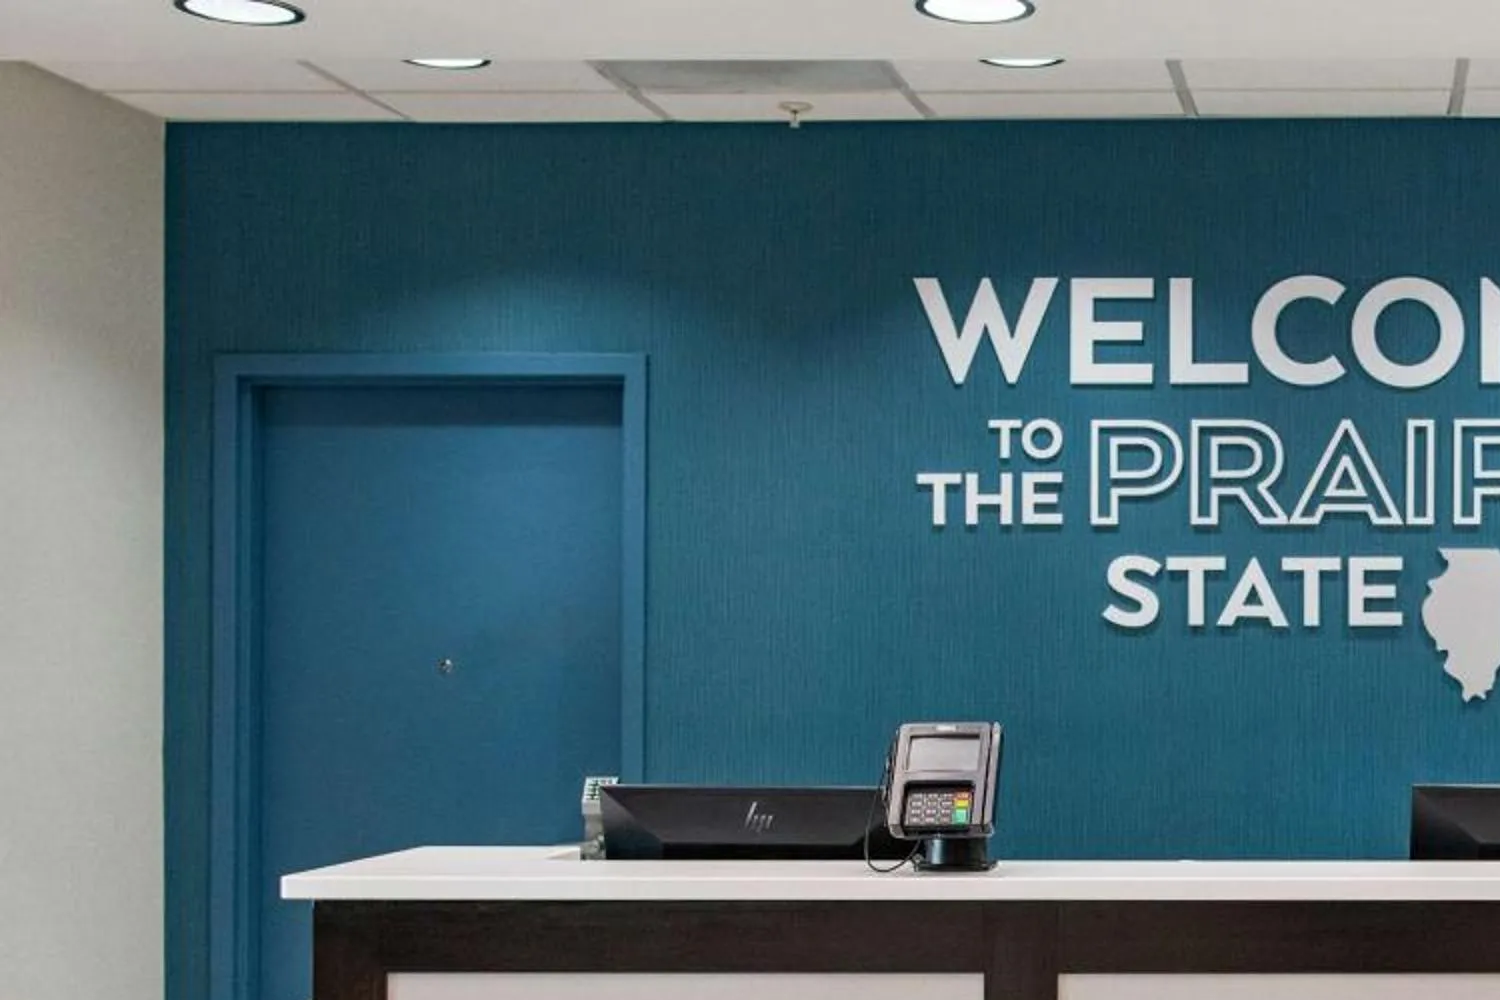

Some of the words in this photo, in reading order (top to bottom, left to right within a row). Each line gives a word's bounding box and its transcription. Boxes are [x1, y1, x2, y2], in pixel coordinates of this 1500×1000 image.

[988, 418, 1064, 460] TO
[916, 472, 1064, 526] THE
[1101, 555, 1404, 630] STATE
